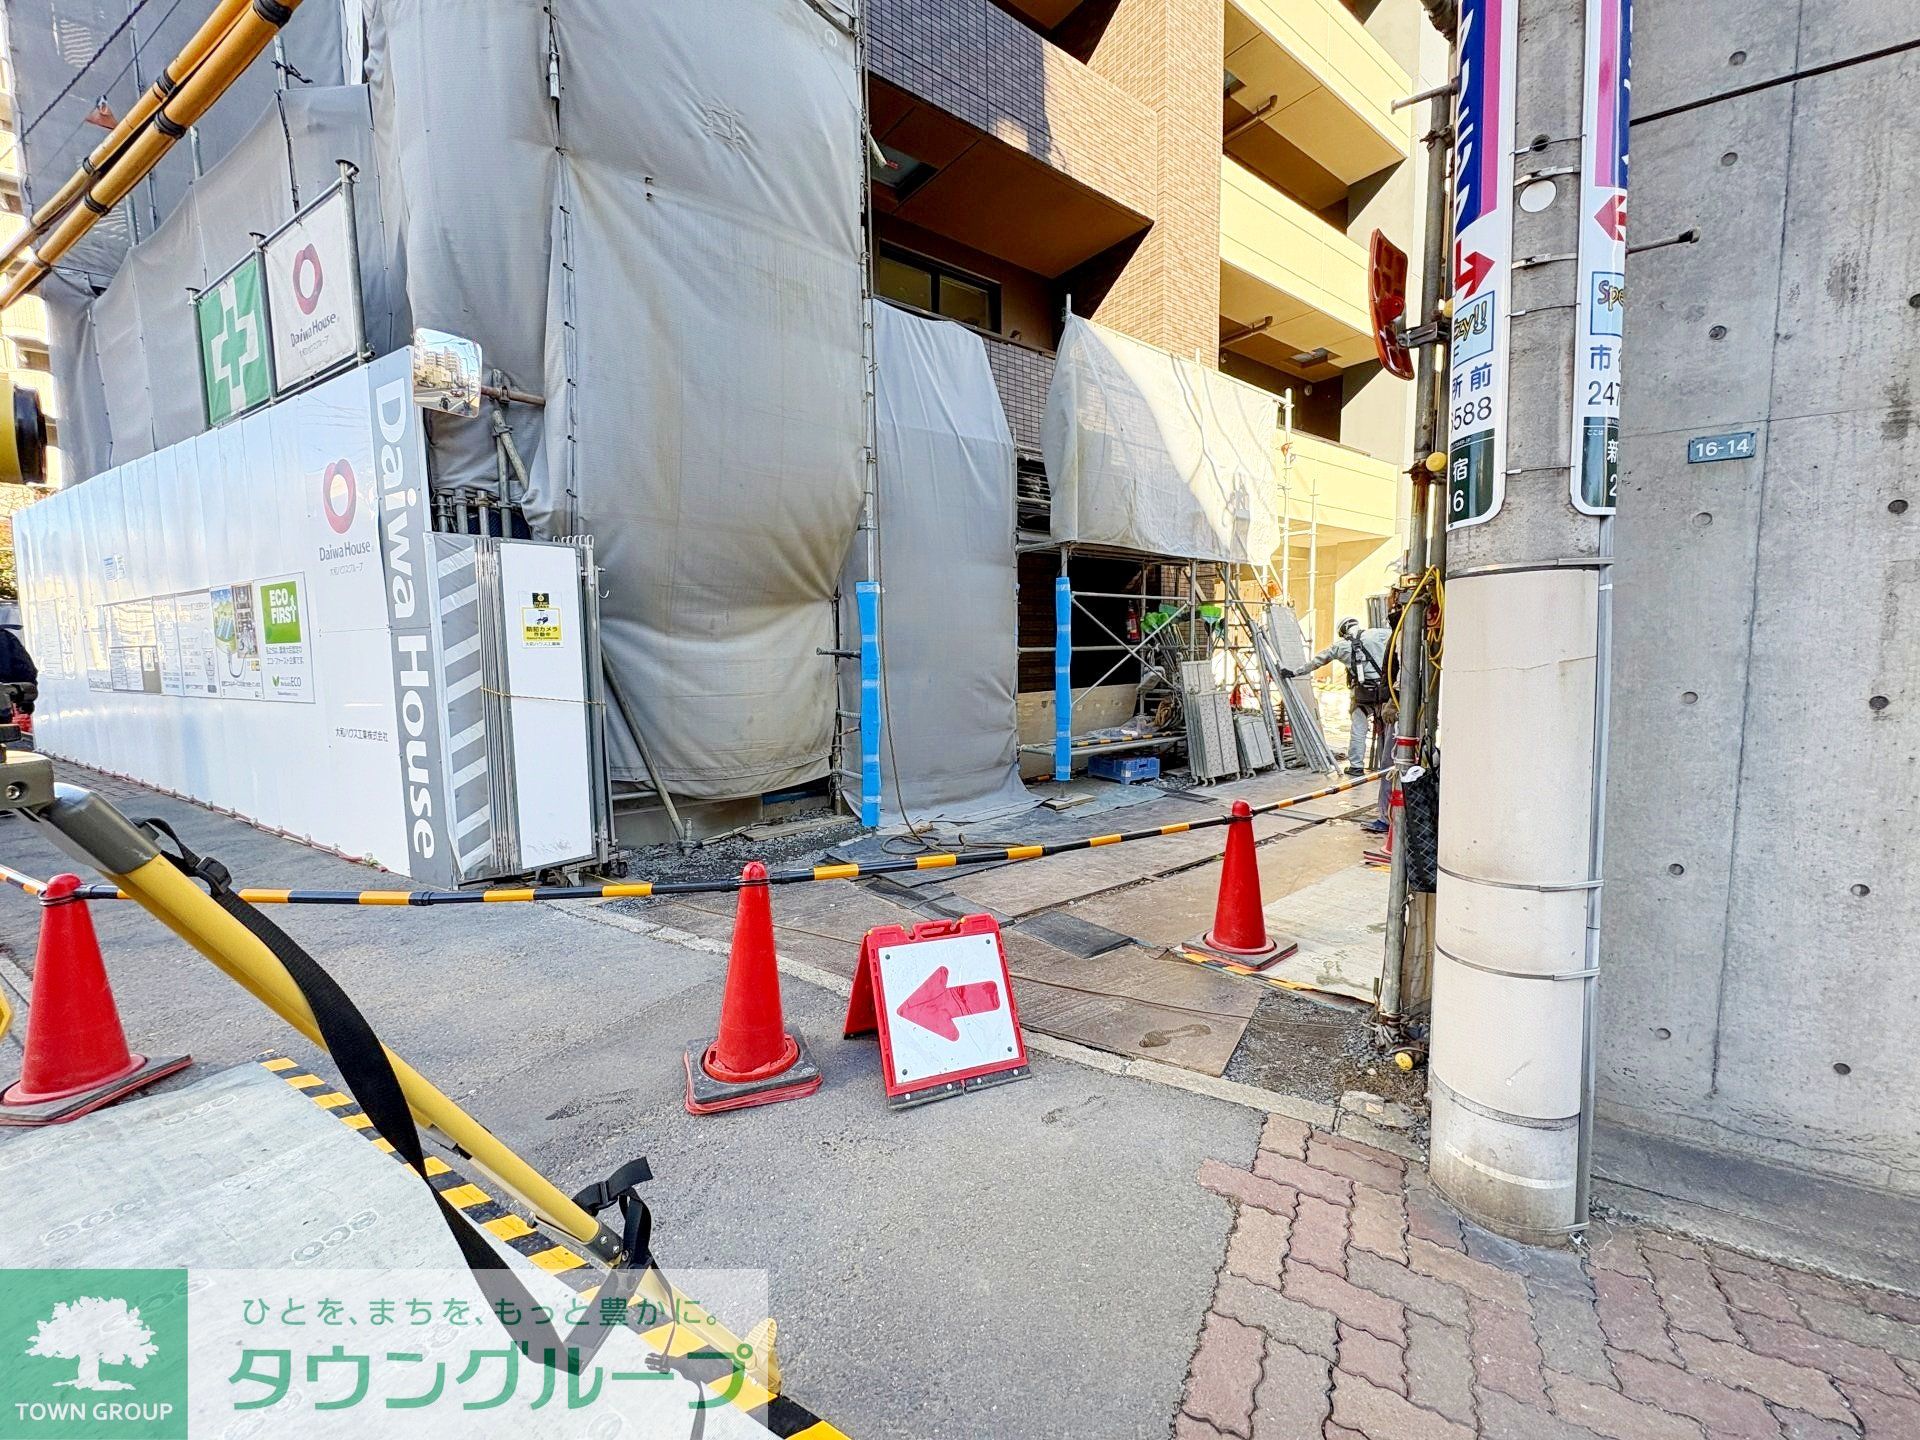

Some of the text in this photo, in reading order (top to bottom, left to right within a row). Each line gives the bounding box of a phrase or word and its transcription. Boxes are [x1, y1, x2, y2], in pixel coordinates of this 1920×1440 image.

[289, 313, 337, 348] Daiwa House
[1695, 438, 1750, 458] 16-14
[319, 541, 371, 561] Daiwa House
[269, 587, 289, 607] ECO
[271, 600, 297, 625] FIRST
[375, 377, 436, 861] Daiwa House
